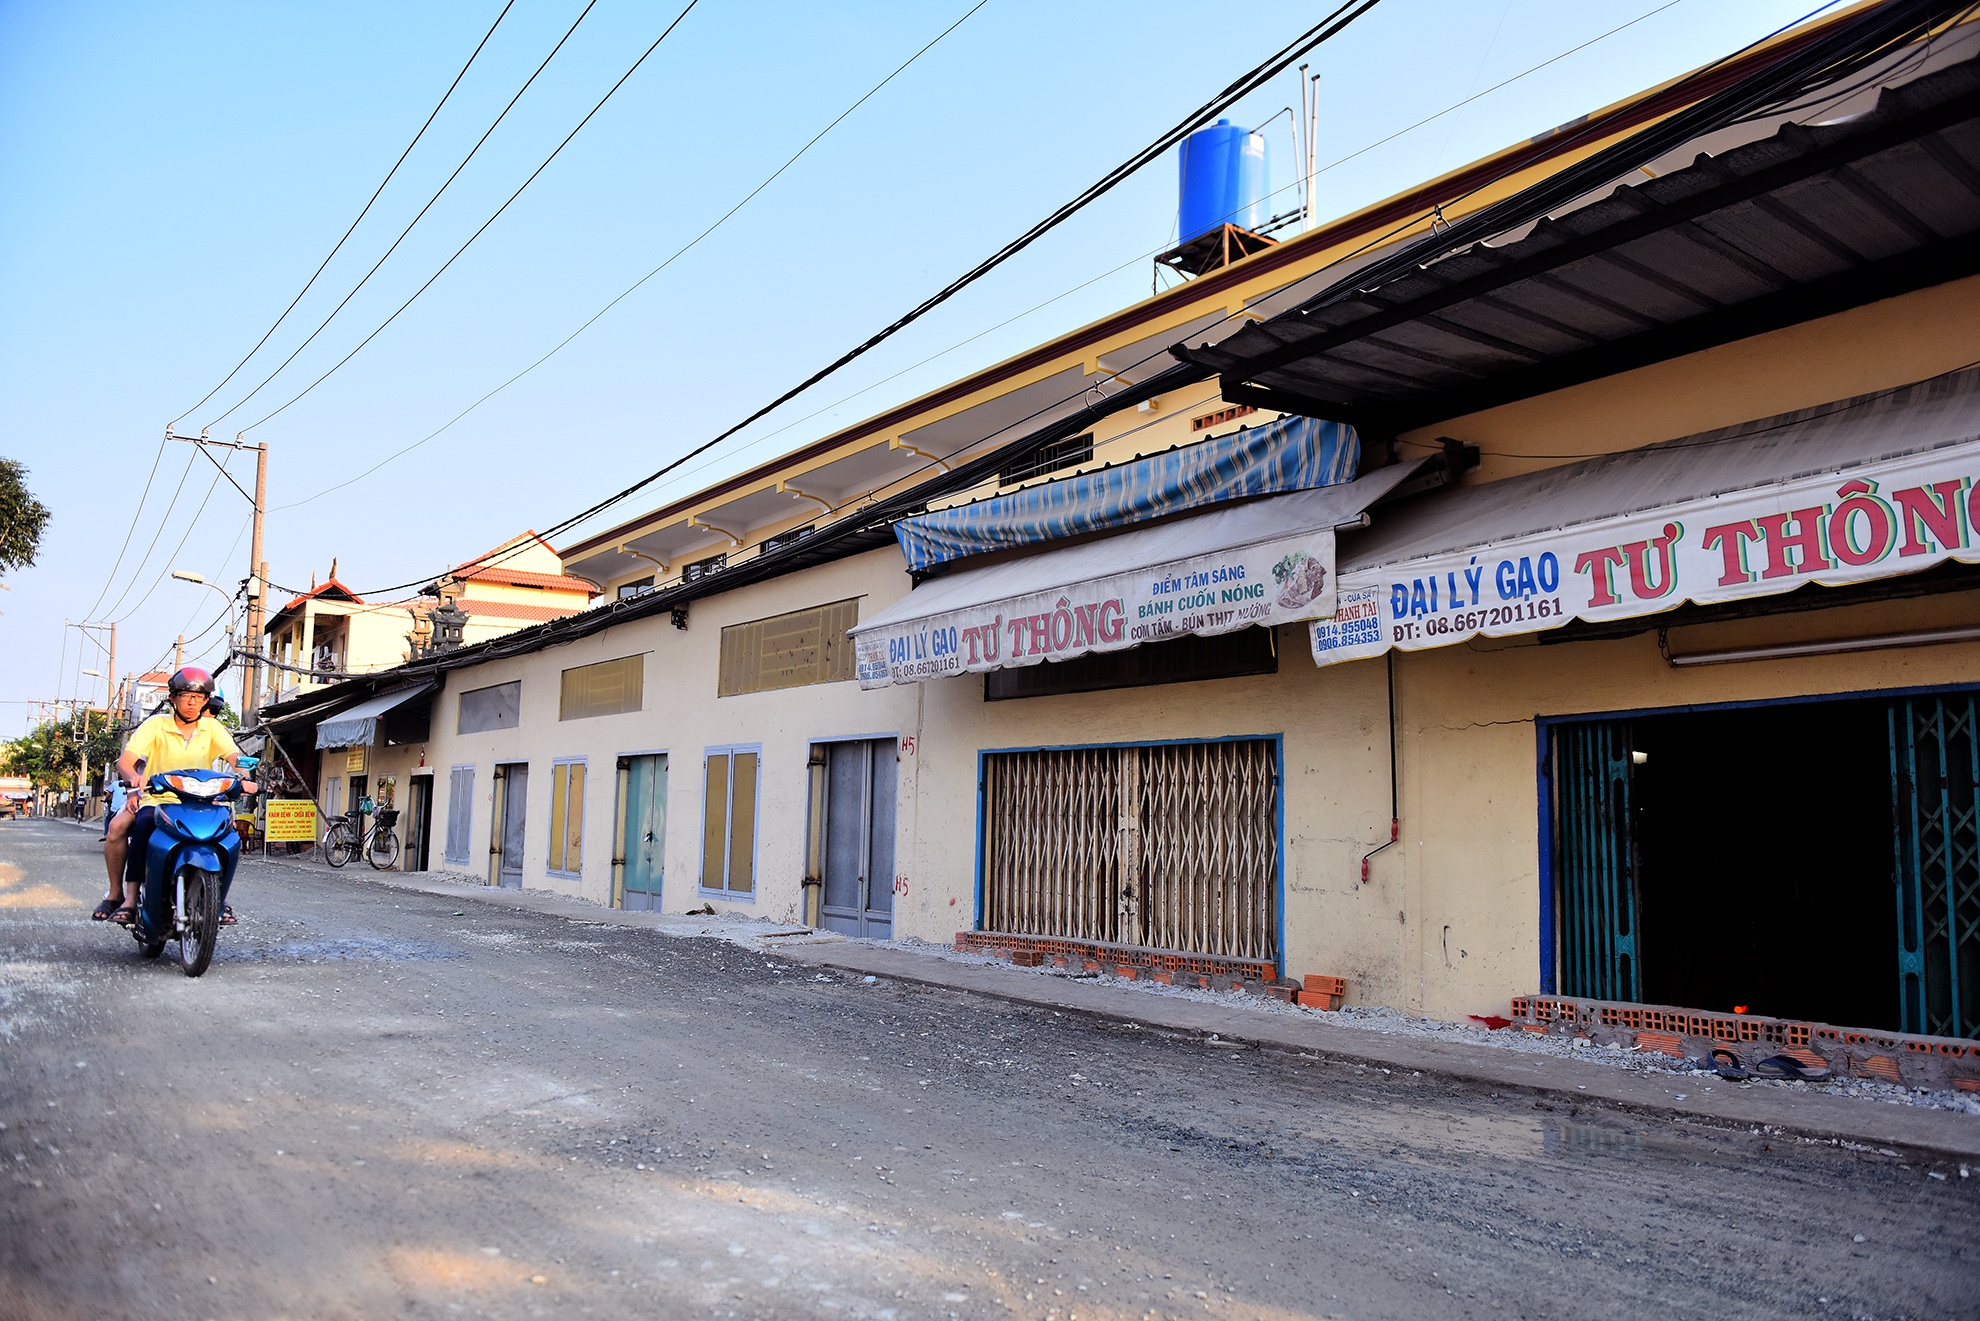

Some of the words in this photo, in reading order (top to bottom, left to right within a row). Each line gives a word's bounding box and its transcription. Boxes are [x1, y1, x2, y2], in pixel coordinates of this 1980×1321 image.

[1574, 521, 1684, 608] TƯ
[1702, 477, 1980, 587] THÔN
[1152, 573, 1181, 595] ĐIỂM
[1184, 571, 1209, 589] TÂM
[1212, 564, 1245, 583] SÁNG
[1390, 576, 1438, 620] ĐẠI
[1447, 556, 1483, 609] LÝ
[1495, 551, 1559, 601] GẠO
[1138, 597, 1173, 619] BÁNH
[1178, 588, 1215, 611] CUỐN
[1221, 583, 1264, 603] NÓNG
[1362, 599, 1377, 617] TÀI
[962, 614, 1002, 665] TƯ
[1007, 595, 1128, 657] THÔNG
[1131, 624, 1149, 640] CƠM
[1151, 616, 1172, 636] TẤM
[1182, 612, 1204, 631] BÚN
[1207, 610, 1234, 627] THỊT
[1236, 602, 1272, 621] NƯỚNG
[1317, 616, 1378, 639] 0914.955048
[1393, 622, 1421, 642] ĐT:
[1425, 597, 1563, 637] 08.667201161
[889, 636, 911, 665] ĐẠI
[914, 625, 928, 659] LÝ
[932, 626, 957, 657] GẠO
[1318, 630, 1379, 652] 0906.854353
[903, 656, 960, 677] 08.667201161
[902, 736, 915, 756] H5
[895, 875, 909, 896] H5
